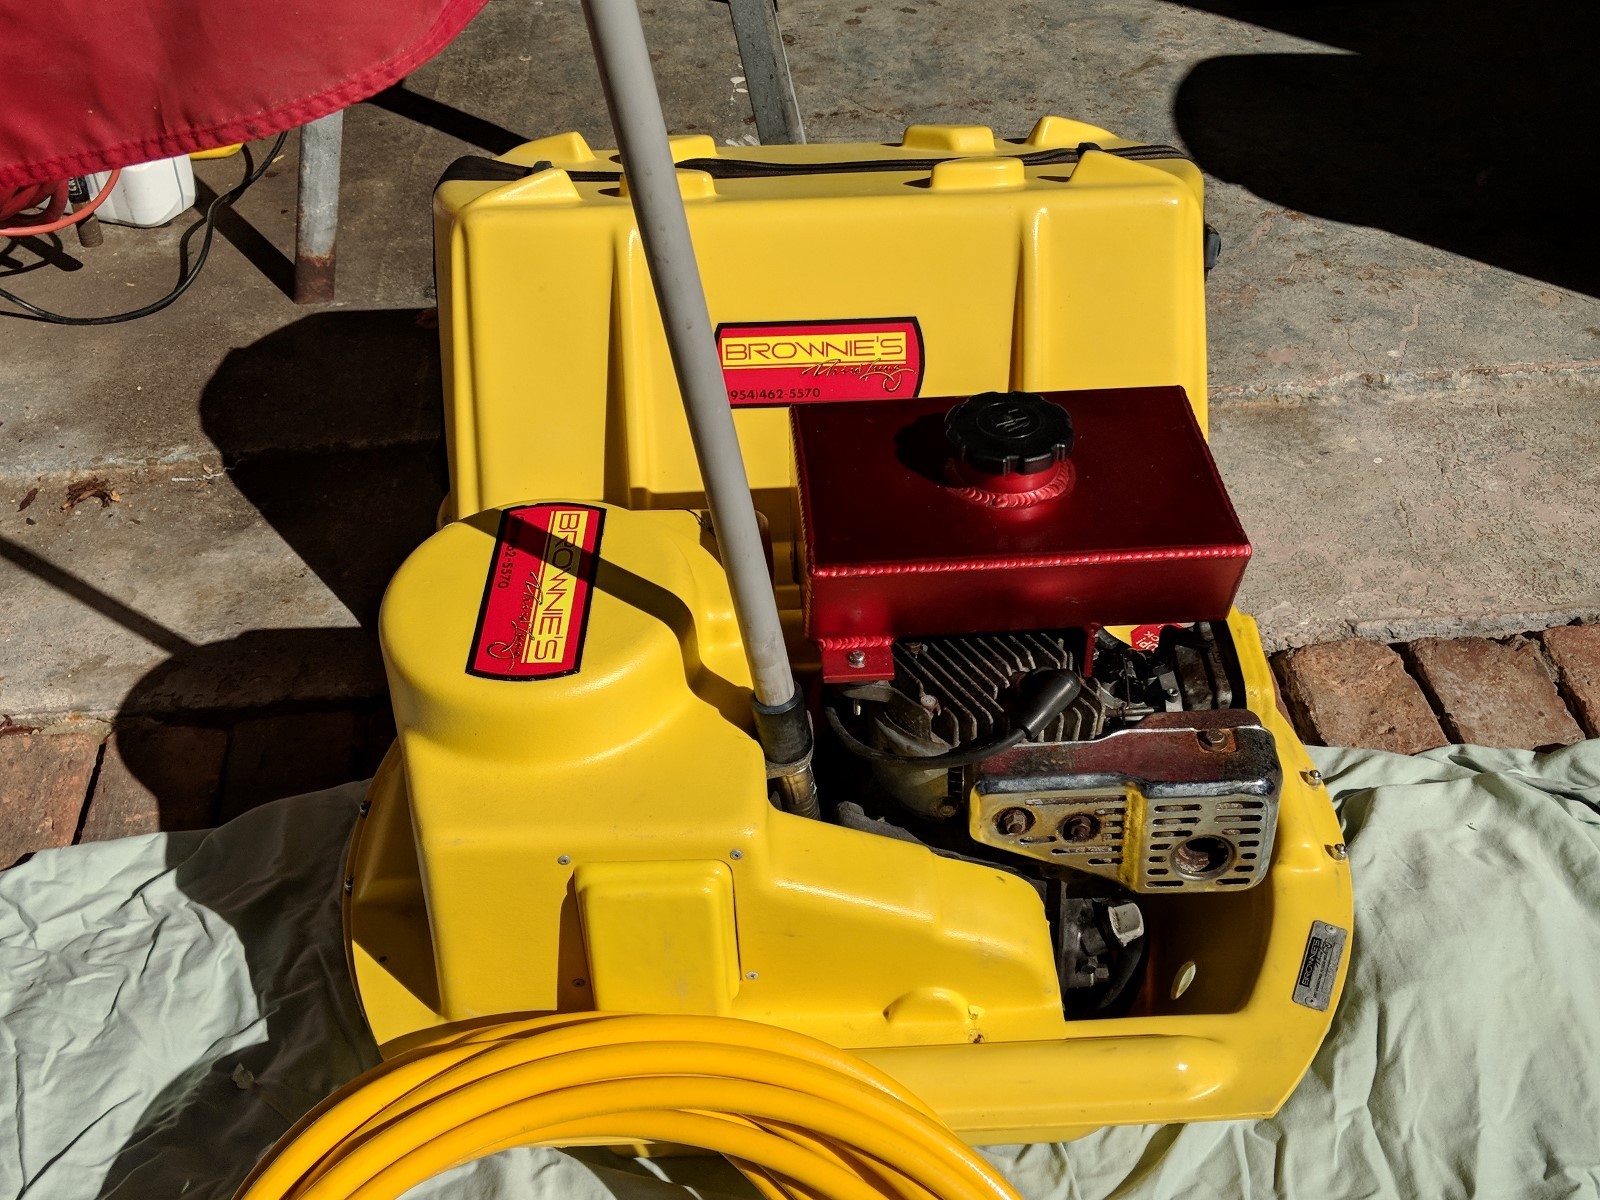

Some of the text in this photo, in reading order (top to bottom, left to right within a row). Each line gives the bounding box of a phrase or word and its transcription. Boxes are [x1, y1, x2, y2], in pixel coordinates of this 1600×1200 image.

[725, 336, 904, 361] BROWNIE'S
[728, 388, 821, 400] 954)462-5570
[534, 513, 581, 660] BROWNIE'S
